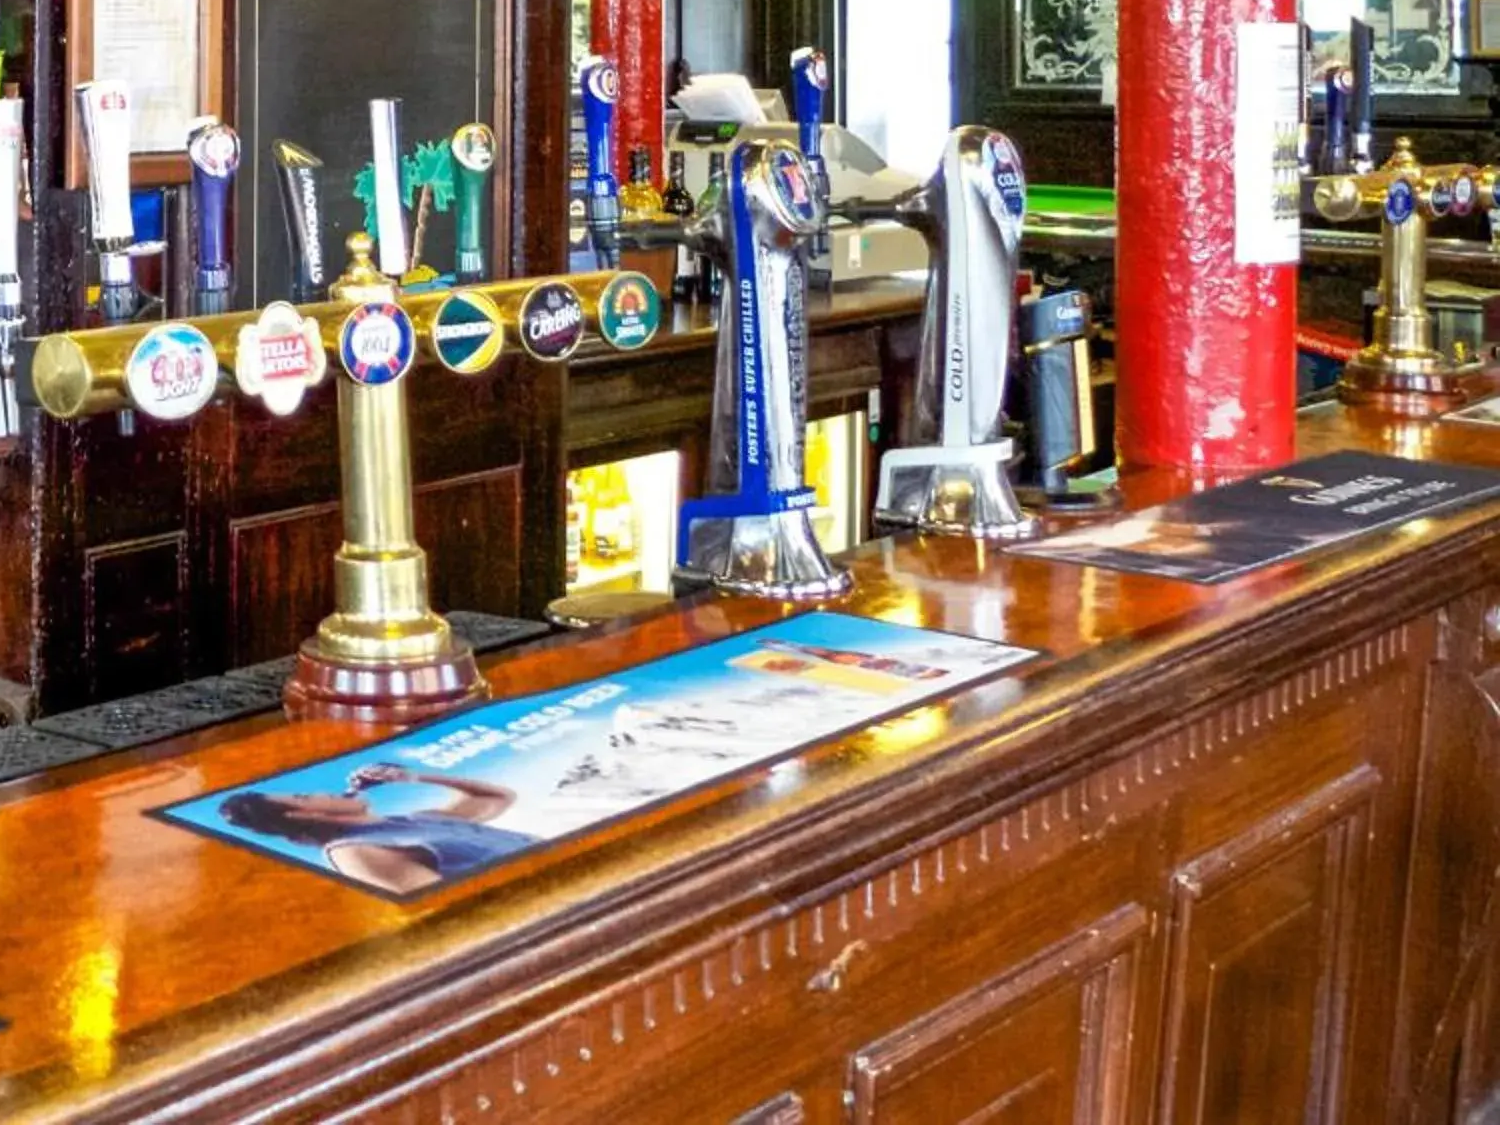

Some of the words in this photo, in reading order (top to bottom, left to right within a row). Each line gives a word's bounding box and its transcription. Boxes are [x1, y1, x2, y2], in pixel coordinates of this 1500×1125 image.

[739, 278, 755, 345] CHILLED
[257, 339, 306, 358] TELLA
[950, 348, 964, 403] COLD
